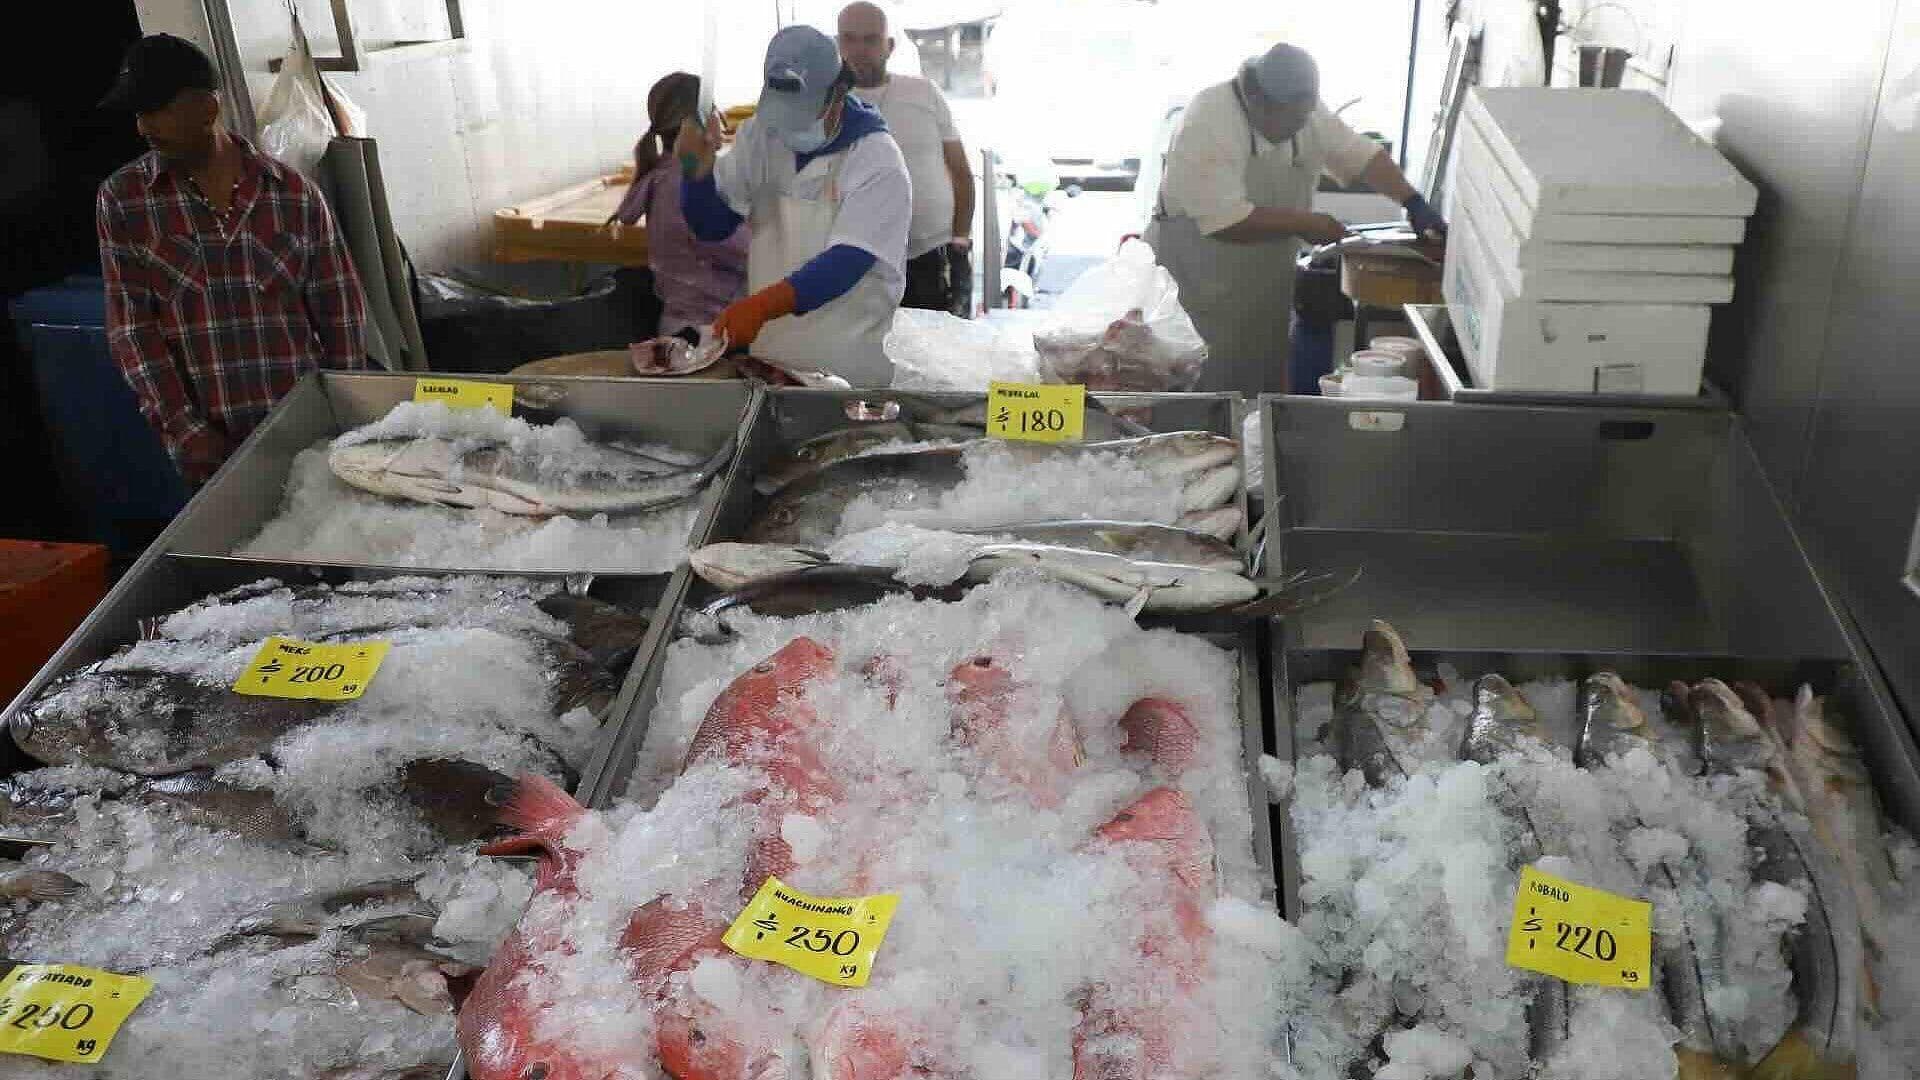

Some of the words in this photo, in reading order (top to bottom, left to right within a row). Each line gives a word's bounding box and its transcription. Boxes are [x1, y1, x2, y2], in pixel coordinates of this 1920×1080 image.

[1021, 408, 1065, 432] 180
[290, 663, 345, 683] 200
[1530, 880, 1570, 903] ROBALO
[784, 926, 860, 956] 250
[1556, 921, 1617, 961] 220
